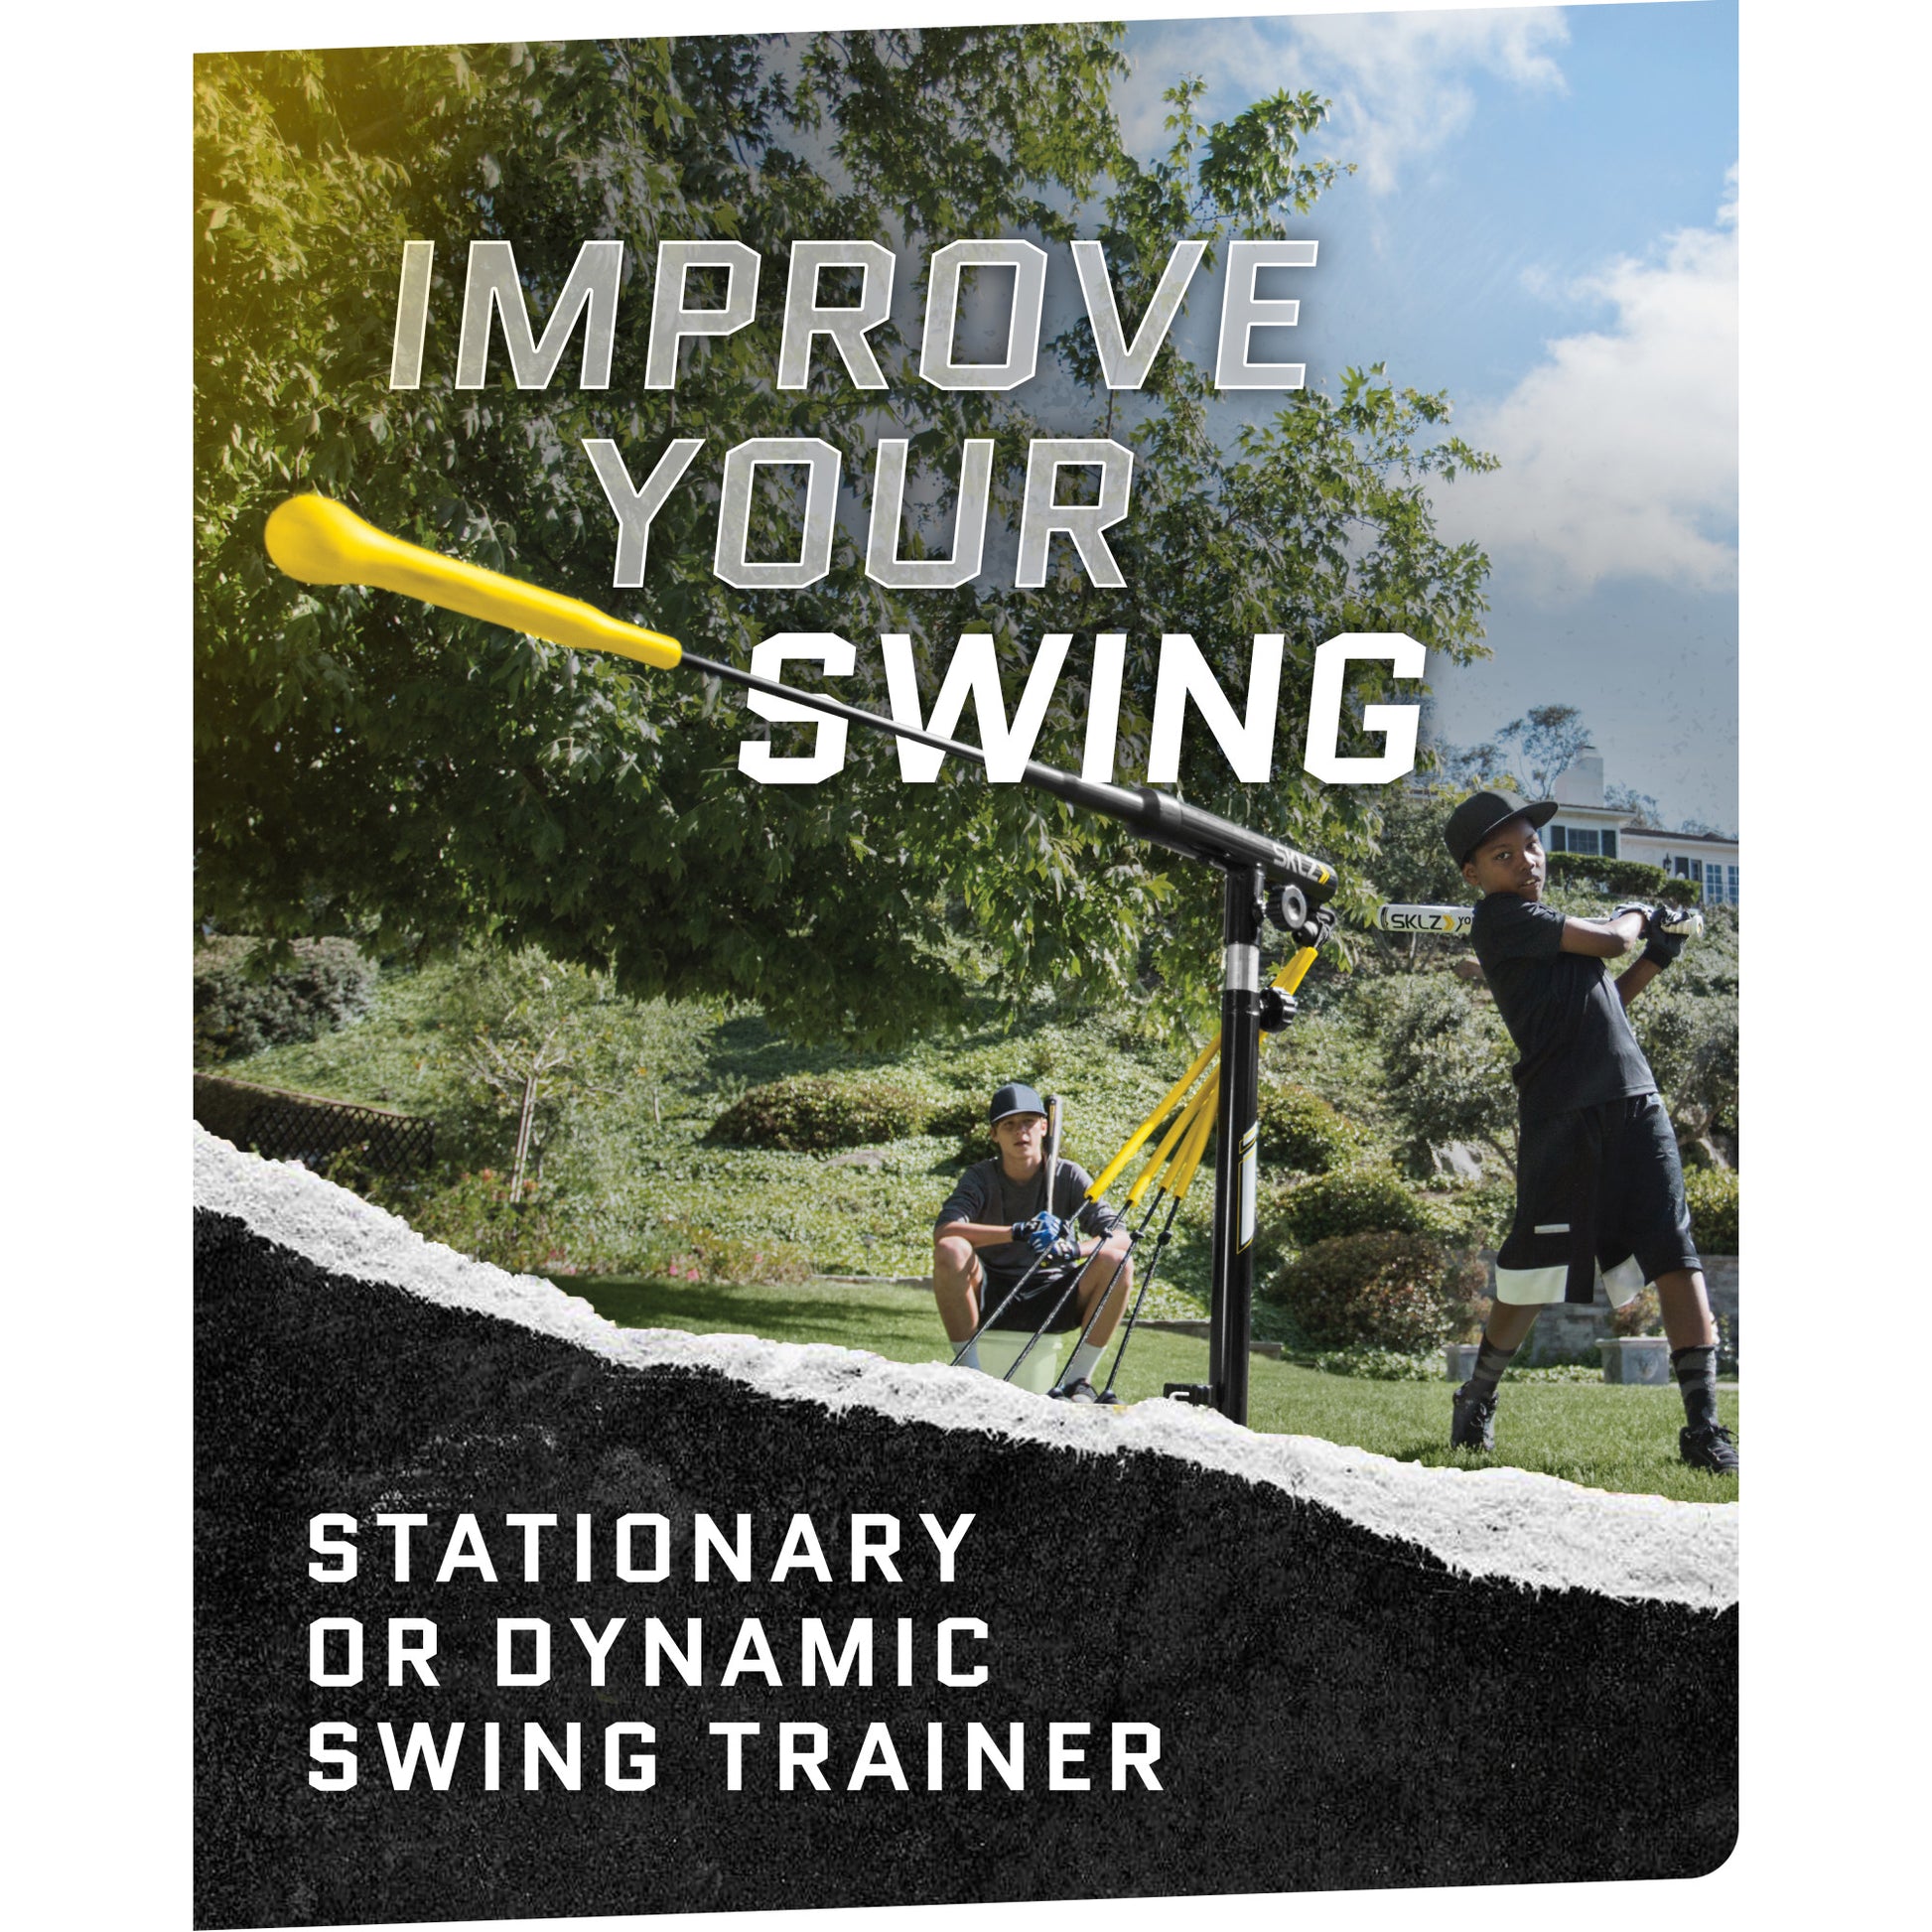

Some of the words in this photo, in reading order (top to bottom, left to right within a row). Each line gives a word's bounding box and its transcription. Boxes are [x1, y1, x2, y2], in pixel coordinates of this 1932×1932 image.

[387, 238, 1320, 393] IMPROVE
[582, 437, 1137, 590] YOUR
[738, 631, 1428, 784] SWING
[1272, 842, 1319, 884] SKLZ
[1390, 912, 1444, 931] SKLZ
[308, 1512, 978, 1584] STATIONARY
[308, 1617, 440, 1688] OR
[496, 1617, 990, 1688] DYNAMIC
[308, 1721, 657, 1792] SWING
[709, 1721, 1165, 1792] TRAINER
